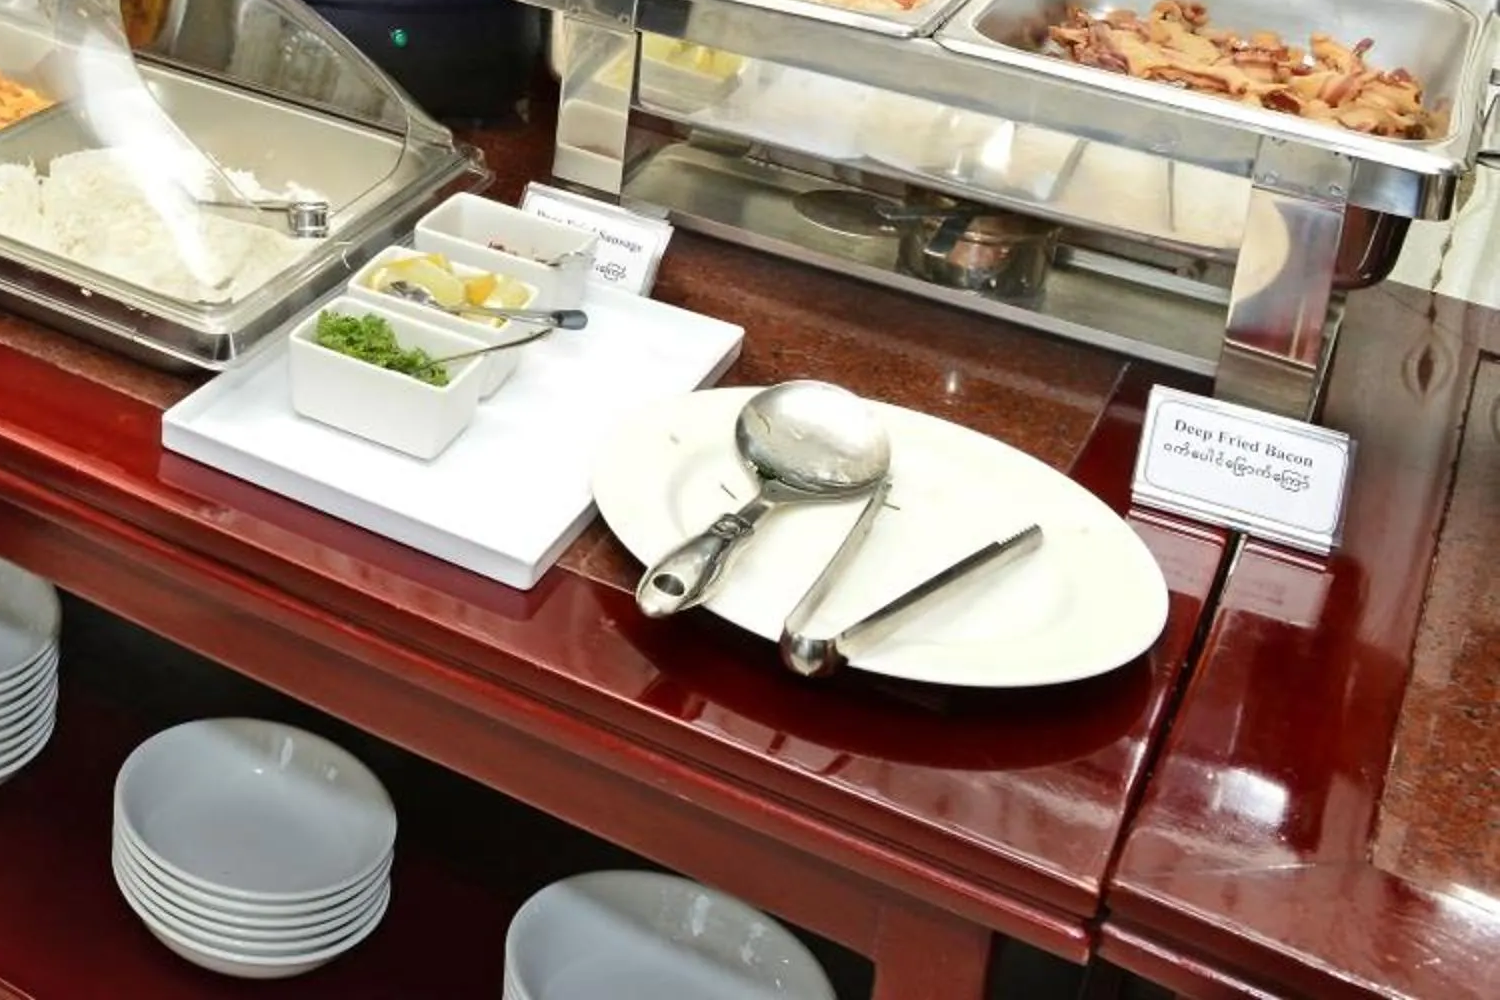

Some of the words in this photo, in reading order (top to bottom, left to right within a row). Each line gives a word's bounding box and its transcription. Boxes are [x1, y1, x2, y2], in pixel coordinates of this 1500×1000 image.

[1174, 419, 1213, 442] Deep
[1218, 431, 1260, 453] Fried
[1264, 443, 1314, 468] Bacon
